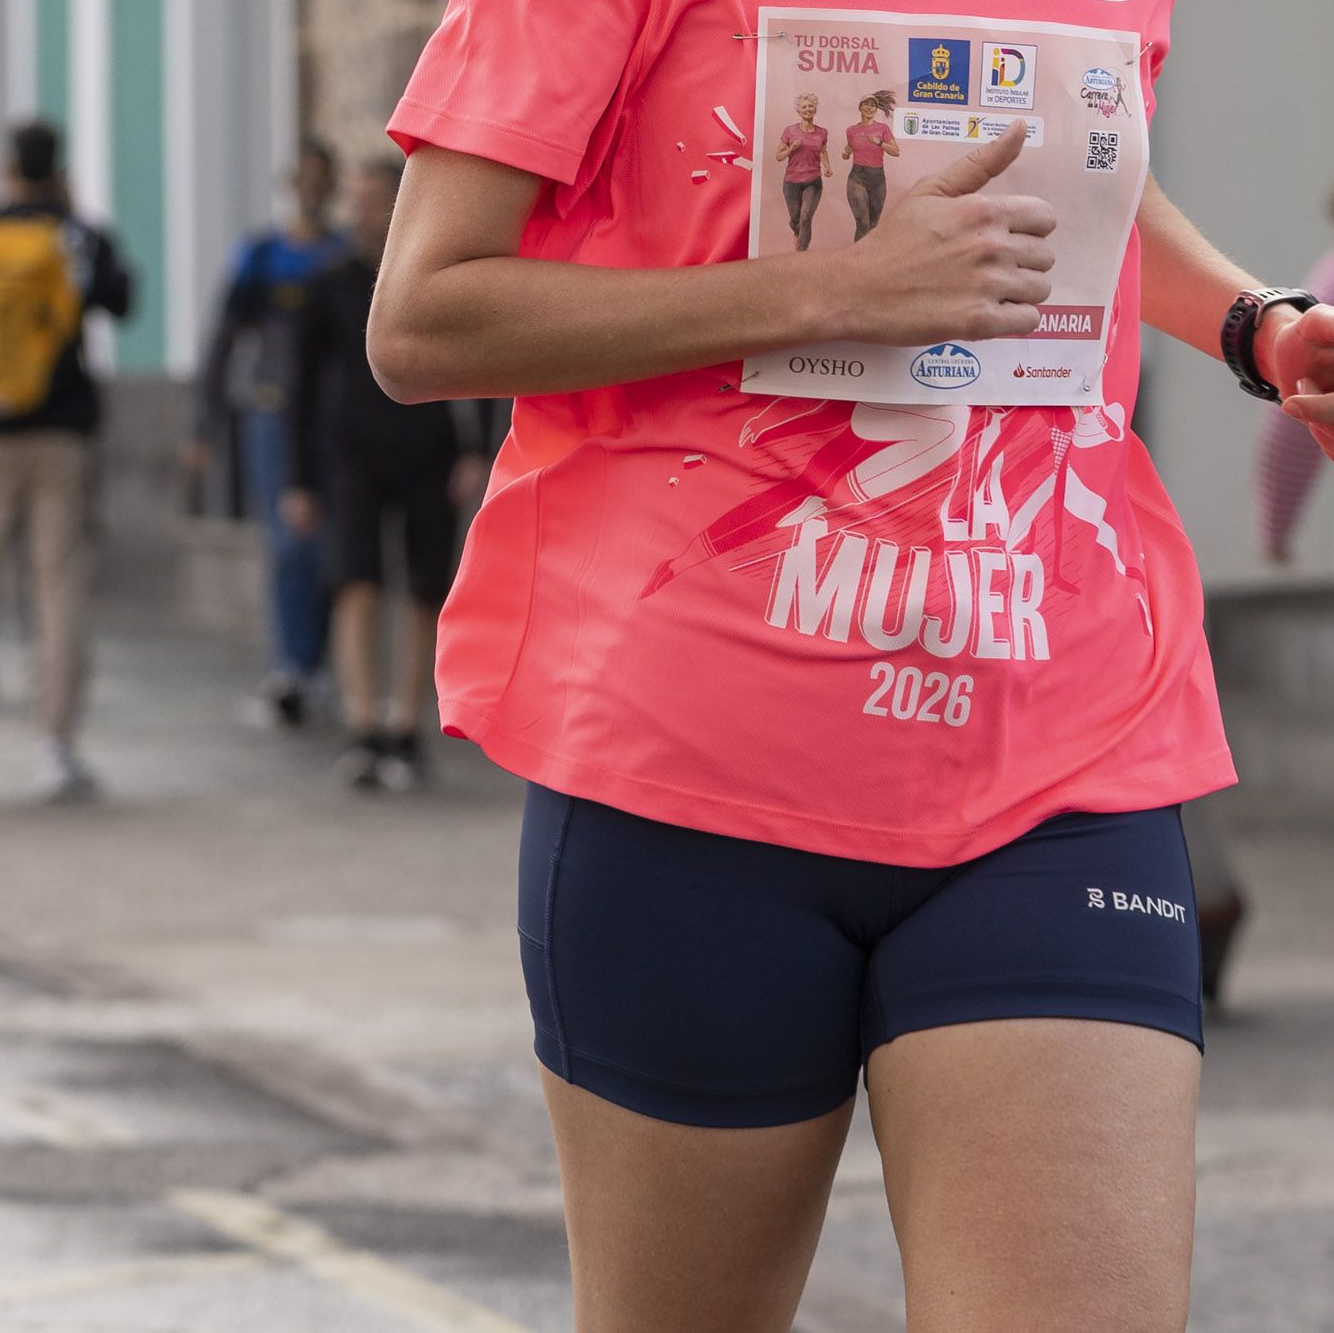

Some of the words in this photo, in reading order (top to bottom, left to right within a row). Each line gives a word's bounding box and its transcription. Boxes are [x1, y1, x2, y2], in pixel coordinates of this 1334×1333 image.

[794, 34, 814, 48] TU
[818, 36, 880, 51] DORSAL
[797, 49, 880, 75] SUMA
[913, 89, 933, 99] Gran
[934, 91, 965, 101] Canaria
[917, 81, 948, 91] Cabildo
[949, 83, 960, 92] de
[995, 94, 1027, 105] DEPORTES
[1033, 313, 1092, 333] ANARIA
[789, 356, 864, 377] OYSHO
[916, 359, 976, 378] ASTURIANA
[1026, 366, 1072, 378] Santander
[940, 406, 1011, 542] LA
[765, 516, 1051, 661] MUJER
[862, 660, 975, 728] 2026
[1112, 891, 1186, 924] BANDIT
